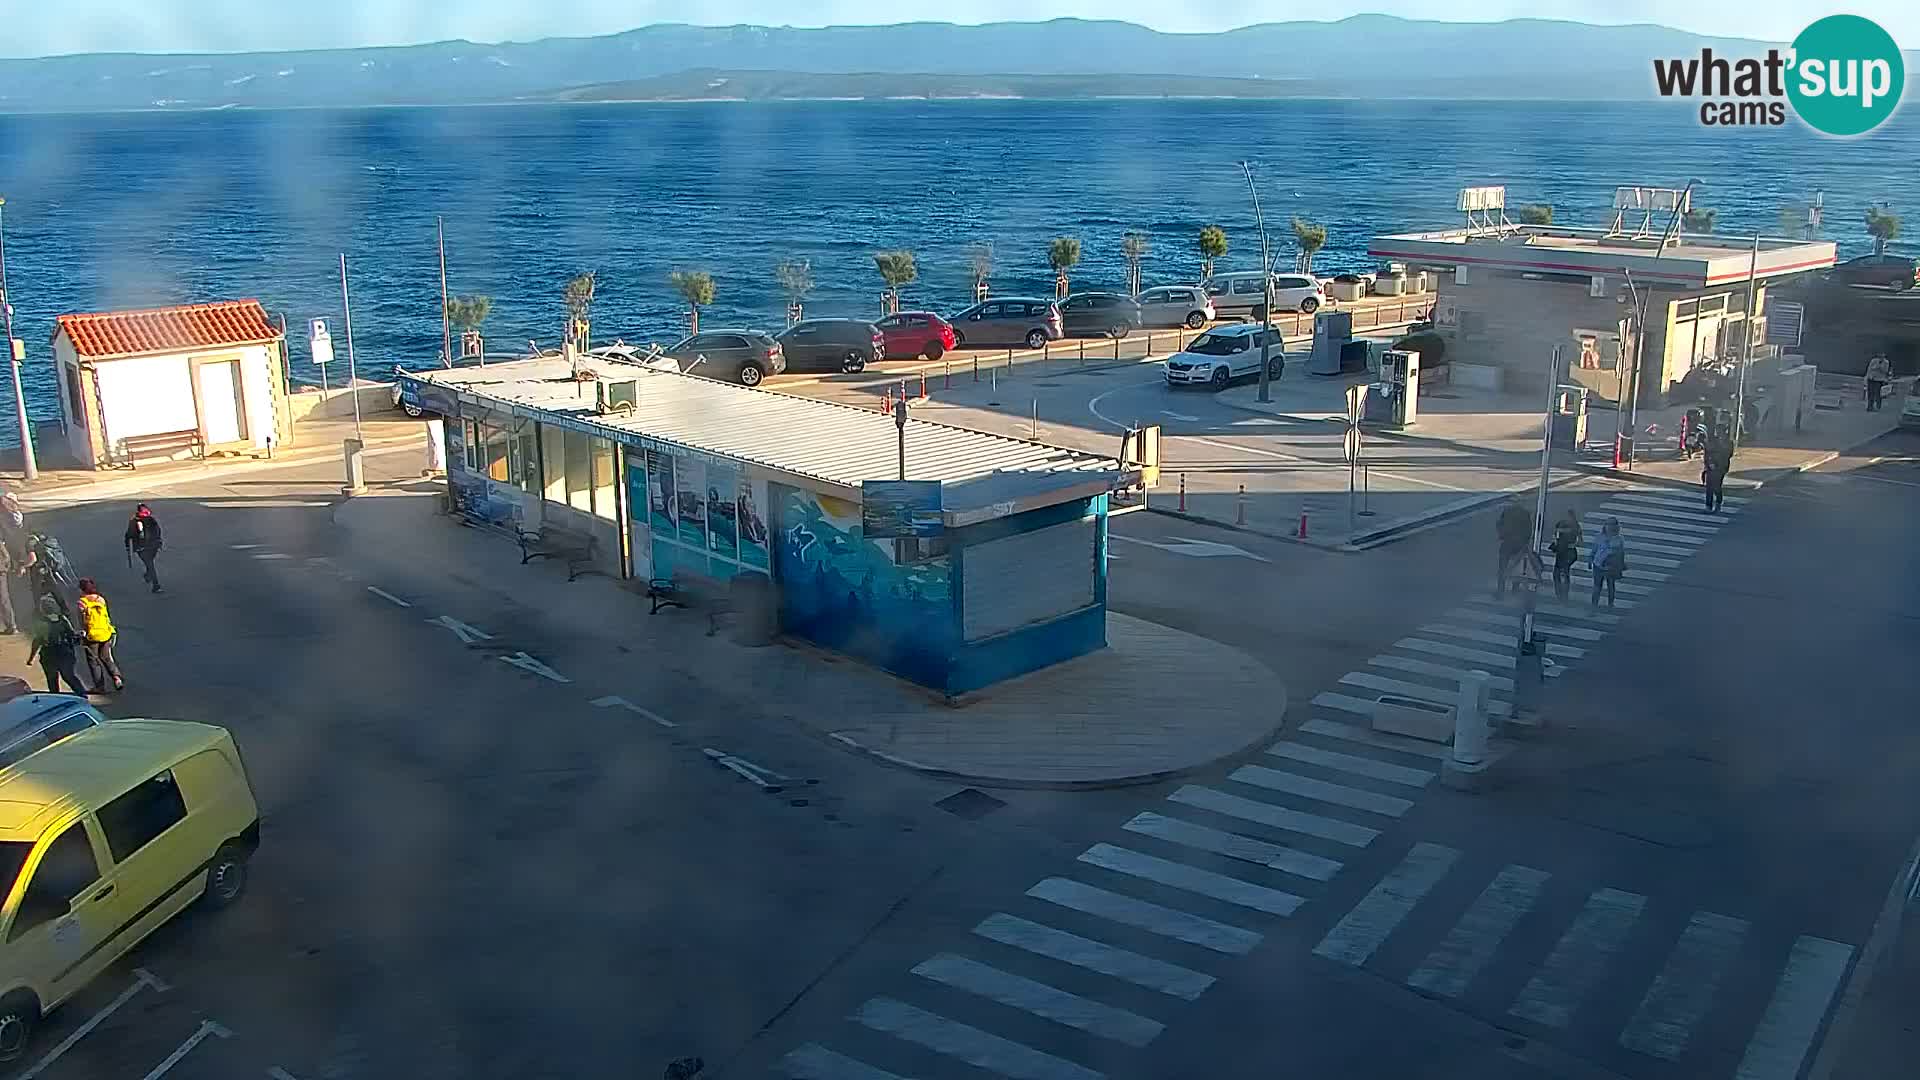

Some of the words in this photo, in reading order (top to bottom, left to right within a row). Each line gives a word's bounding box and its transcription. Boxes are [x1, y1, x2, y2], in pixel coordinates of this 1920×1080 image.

[313, 320, 326, 340] P
[641, 438, 655, 450] BUS
[656, 442, 688, 457] STATION
